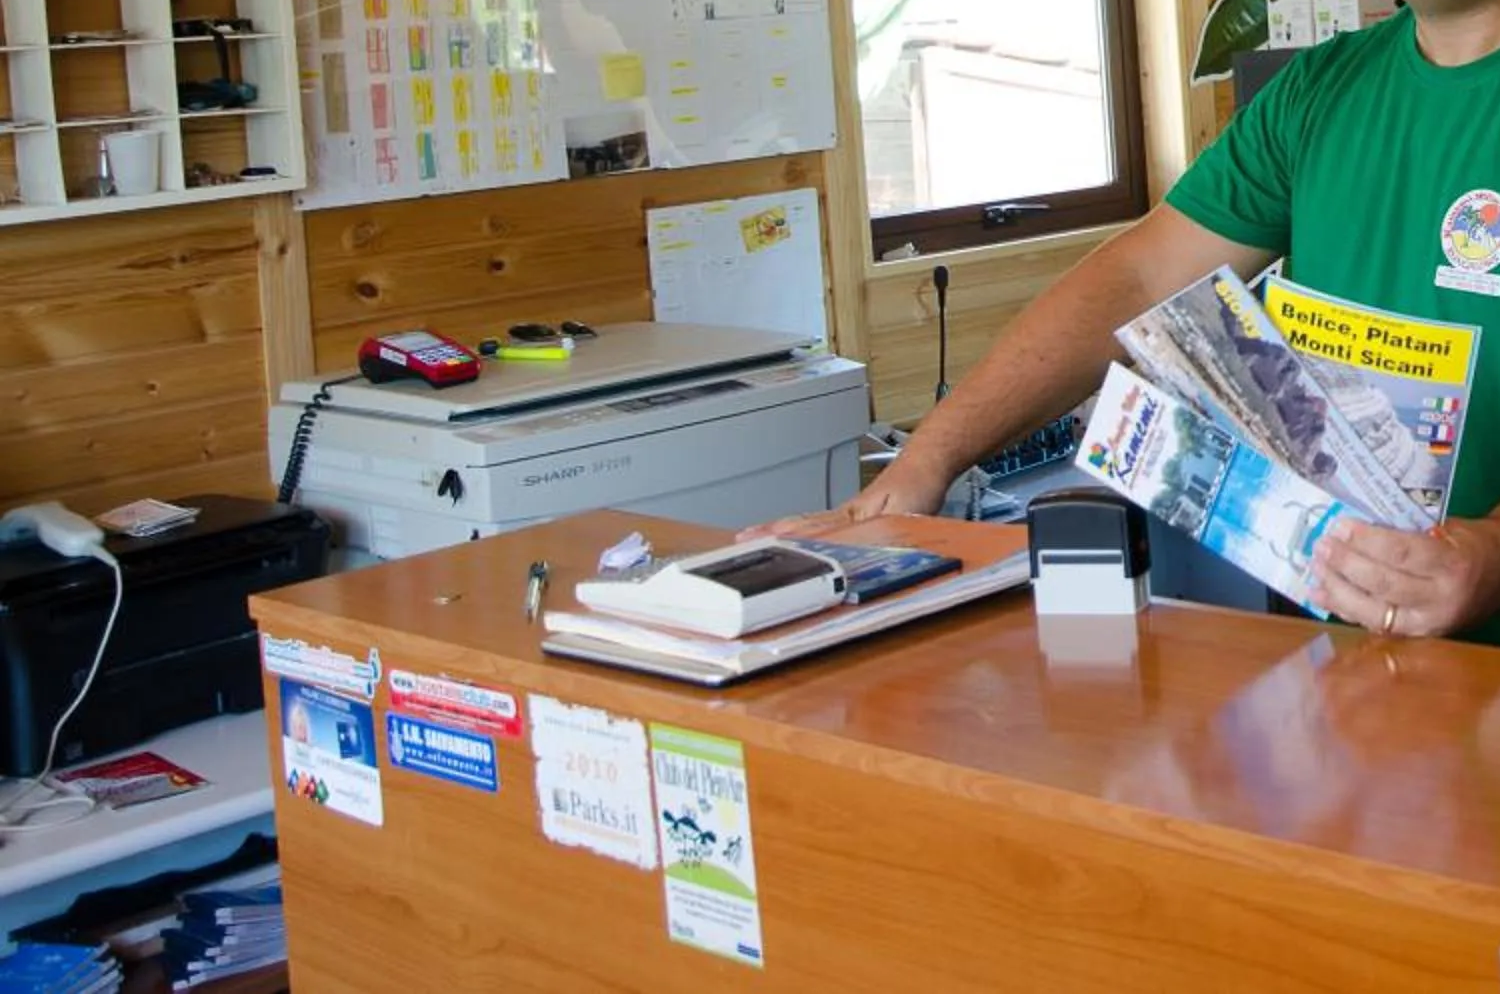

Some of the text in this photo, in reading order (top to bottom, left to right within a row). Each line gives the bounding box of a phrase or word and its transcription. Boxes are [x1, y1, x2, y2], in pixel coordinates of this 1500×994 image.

[1281, 302, 1358, 341] Belice,
[1366, 326, 1453, 356] Platani
[1289, 329, 1435, 378] Monti Sicani
[523, 463, 585, 487] SHARP
[564, 751, 619, 784] 2010
[569, 789, 639, 835] Parks.it
